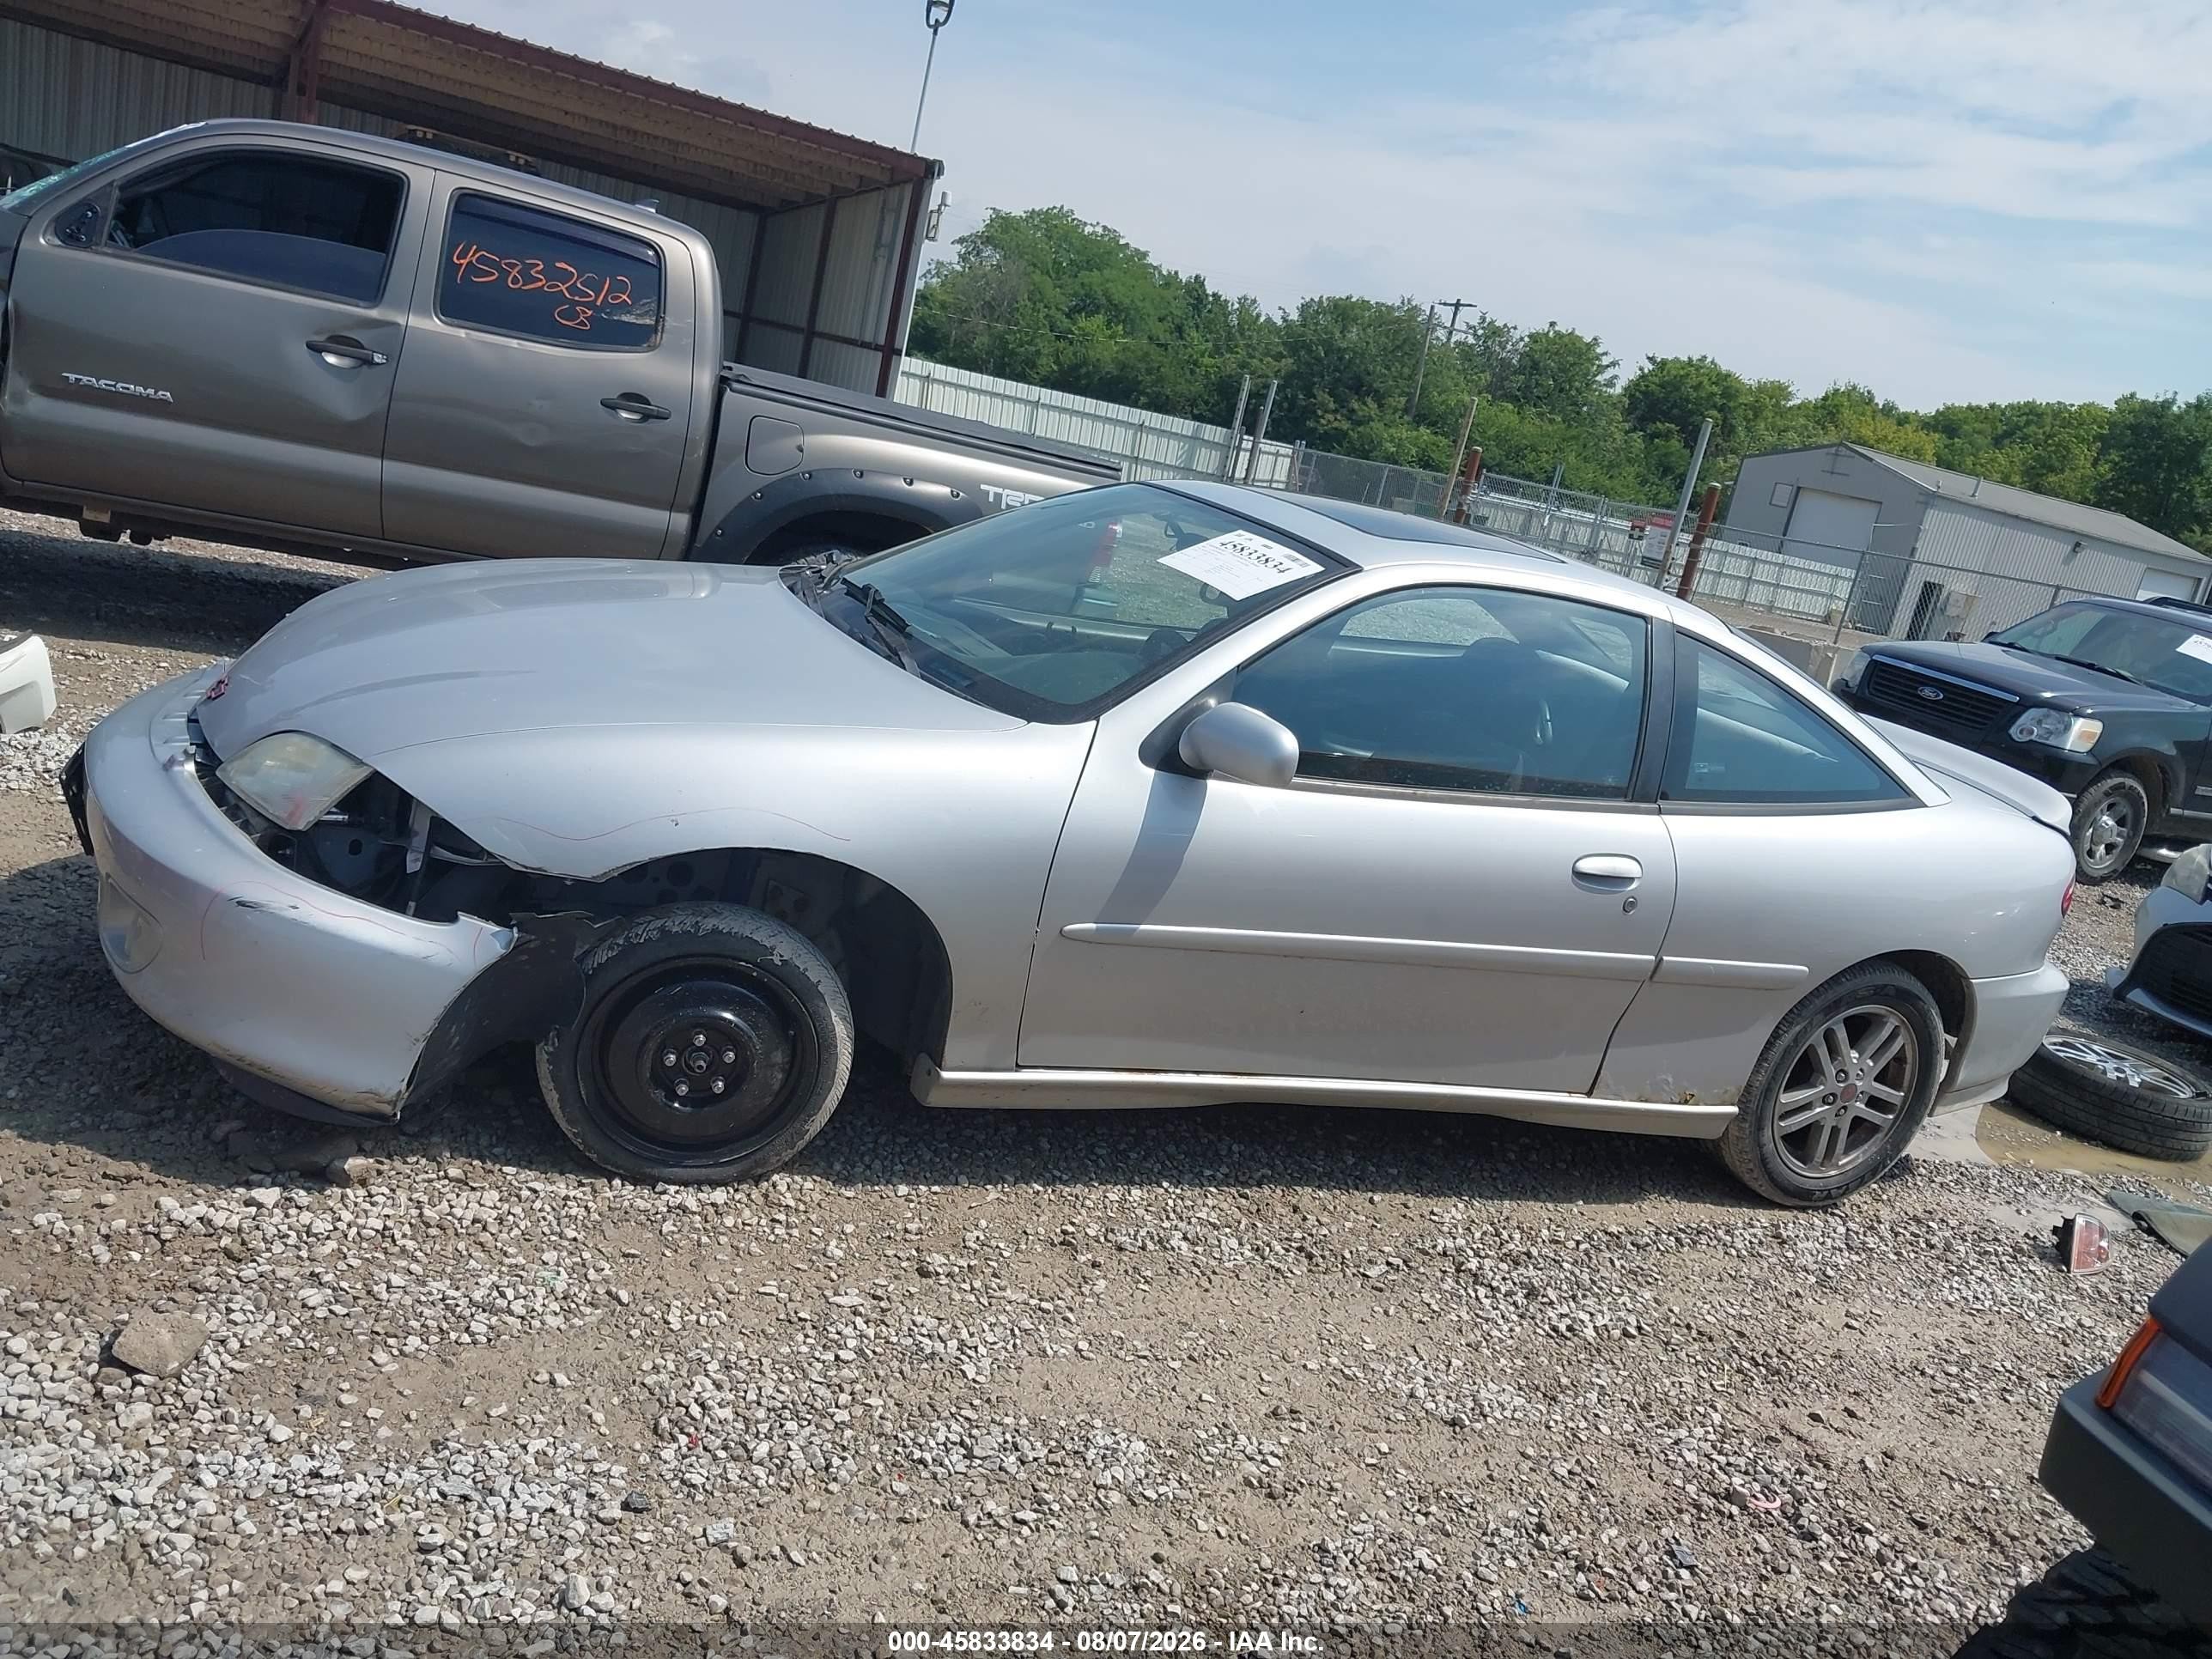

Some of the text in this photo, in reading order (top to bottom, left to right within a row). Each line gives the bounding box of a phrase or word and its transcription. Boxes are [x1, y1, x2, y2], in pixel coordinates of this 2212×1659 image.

[453, 240, 632, 306] 45832512
[61, 372, 173, 403] TACOMA
[1218, 540, 1292, 574] 45833834
